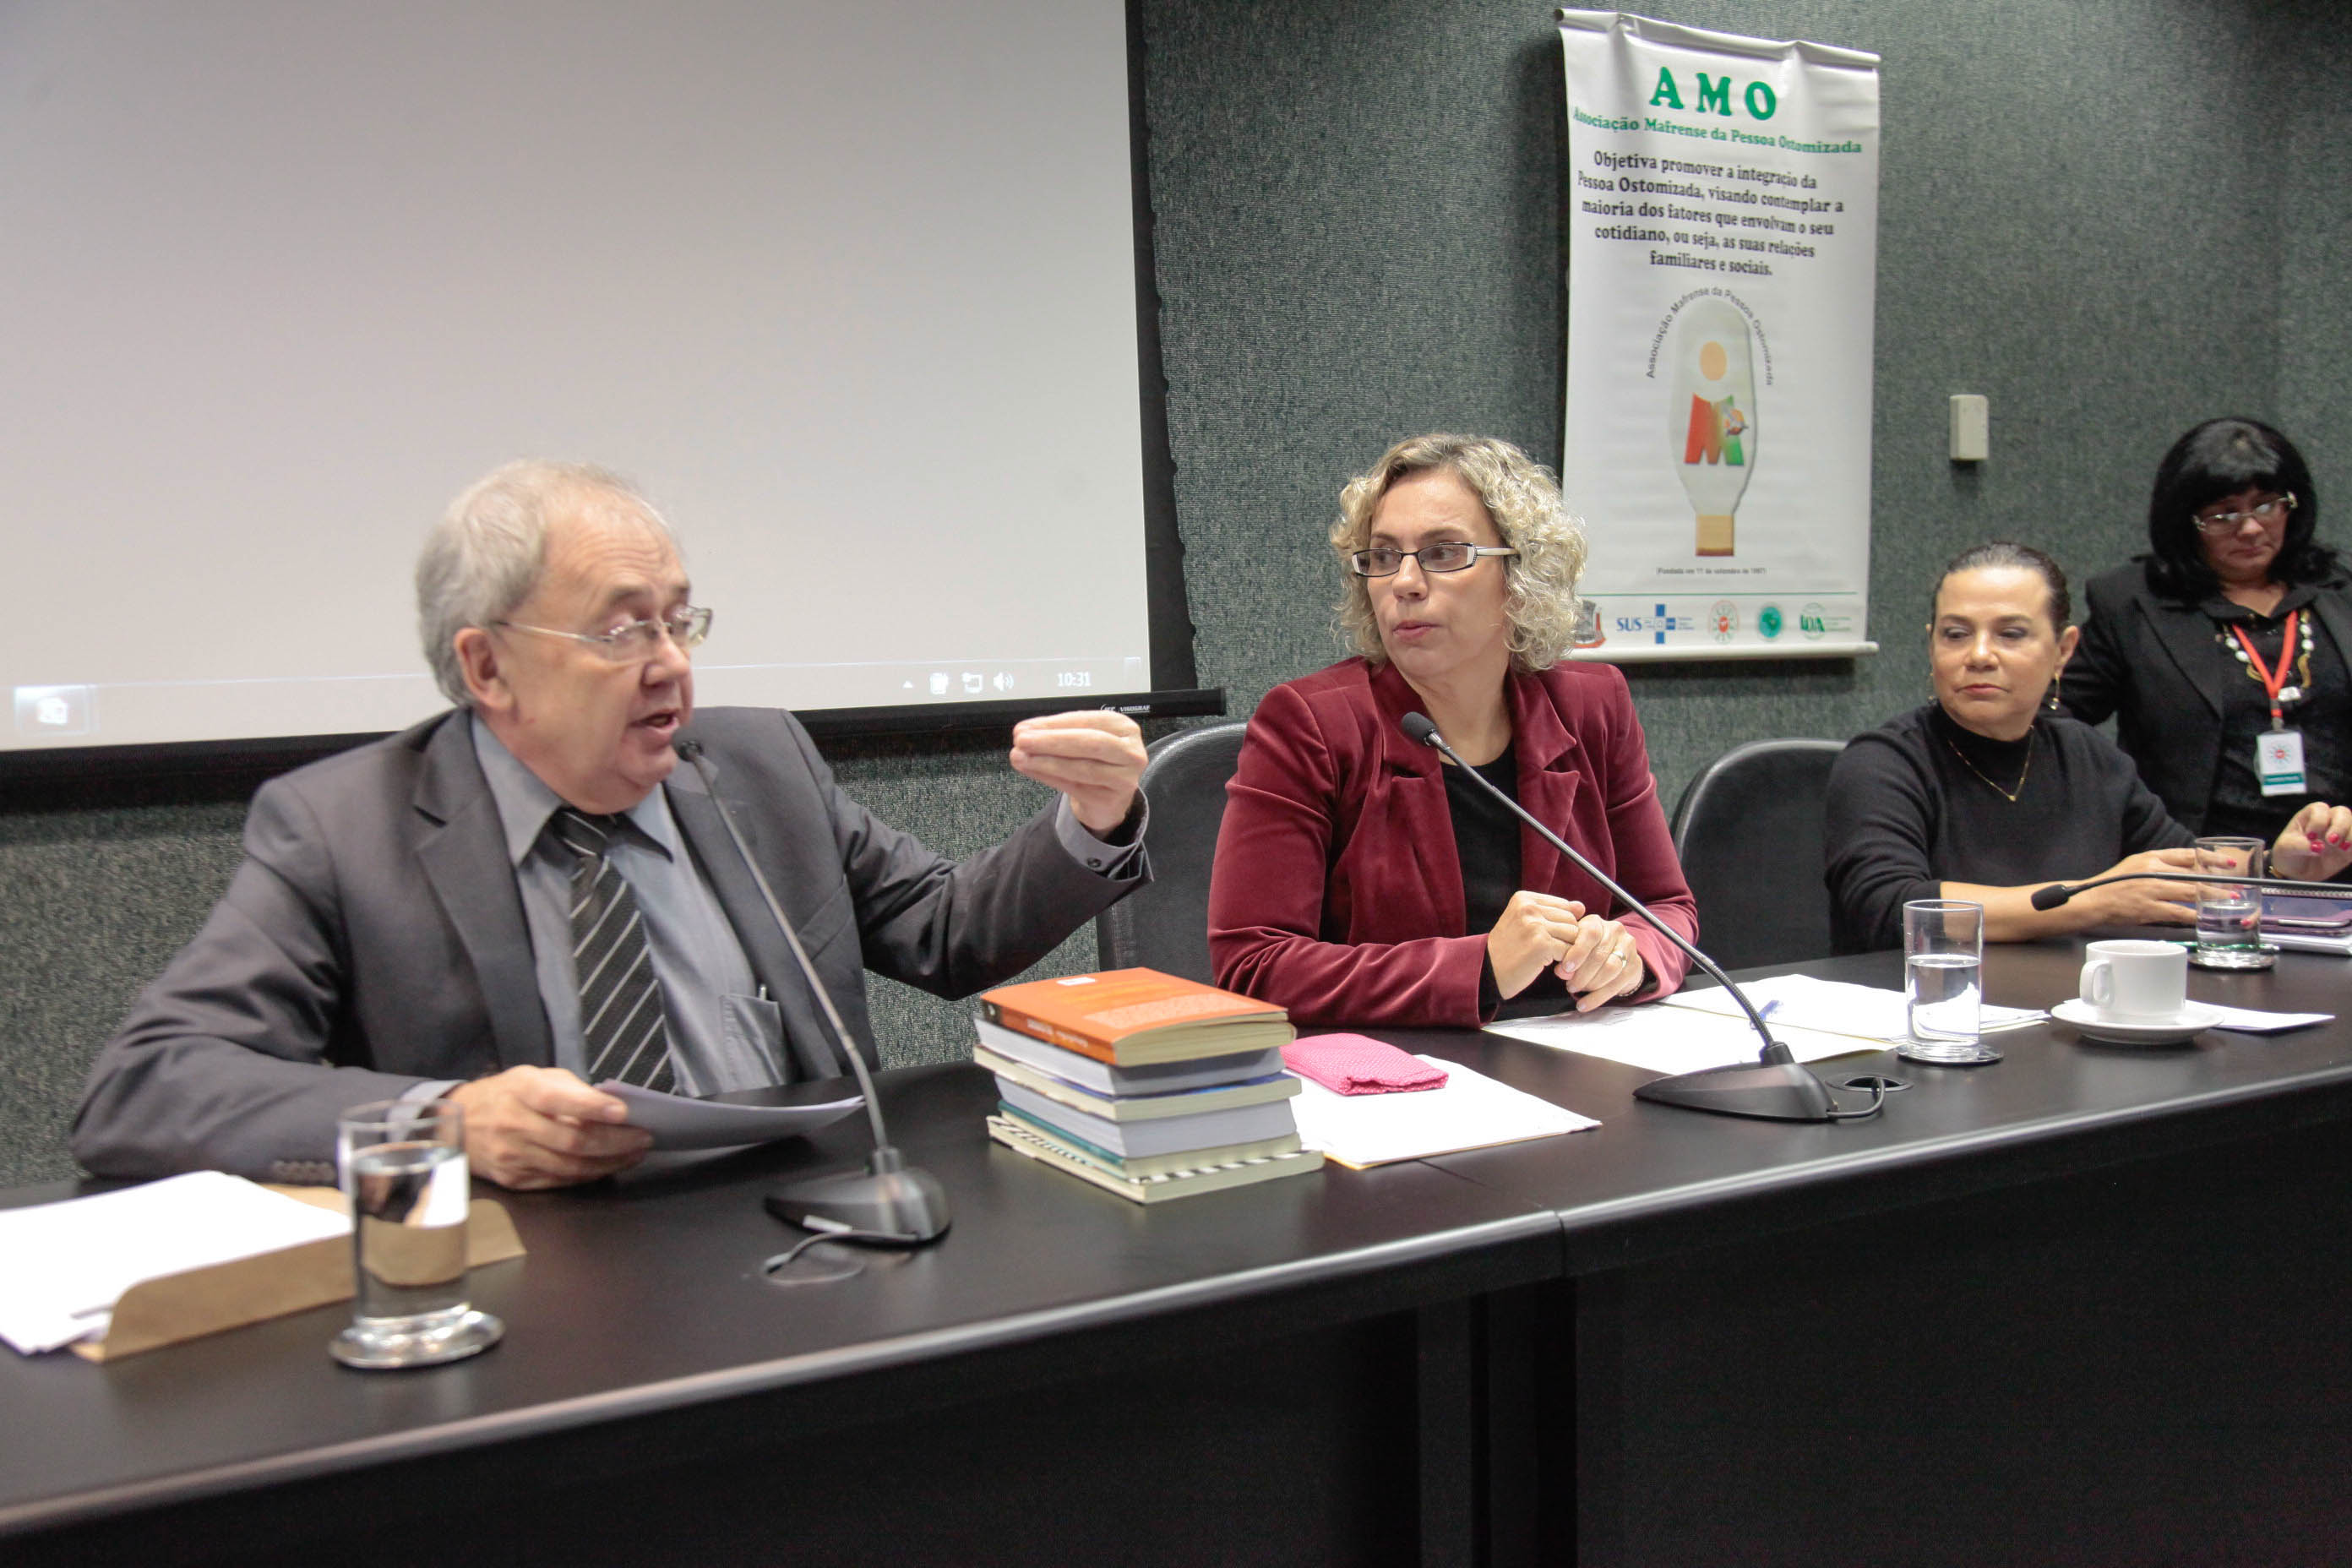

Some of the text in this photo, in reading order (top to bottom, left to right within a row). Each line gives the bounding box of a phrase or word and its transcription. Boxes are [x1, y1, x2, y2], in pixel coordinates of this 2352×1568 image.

[1649, 66, 1777, 120] AMO
[1644, 117, 1707, 139] Mafrense
[1711, 128, 1727, 141] da
[1731, 129, 1776, 146] Pessoa
[1778, 135, 1862, 154] Ostomizada
[1594, 150, 1657, 172] Objetiva
[1662, 159, 1723, 177] promover
[1727, 168, 1734, 178] a
[1800, 174, 1817, 189] da
[1577, 170, 1843, 215] Pessoa Ostomizada, visando contemplar a
[1582, 199, 1834, 235] maioria dos fatores que envolvam o seu
[1595, 225, 1815, 259] cotidiano, ou seja, as suas relações
[1650, 250, 1773, 275] familiares e sociais.
[1646, 313, 1674, 379] Associação
[1616, 618, 1642, 632] SUS
[1058, 672, 1092, 687] 10:31
